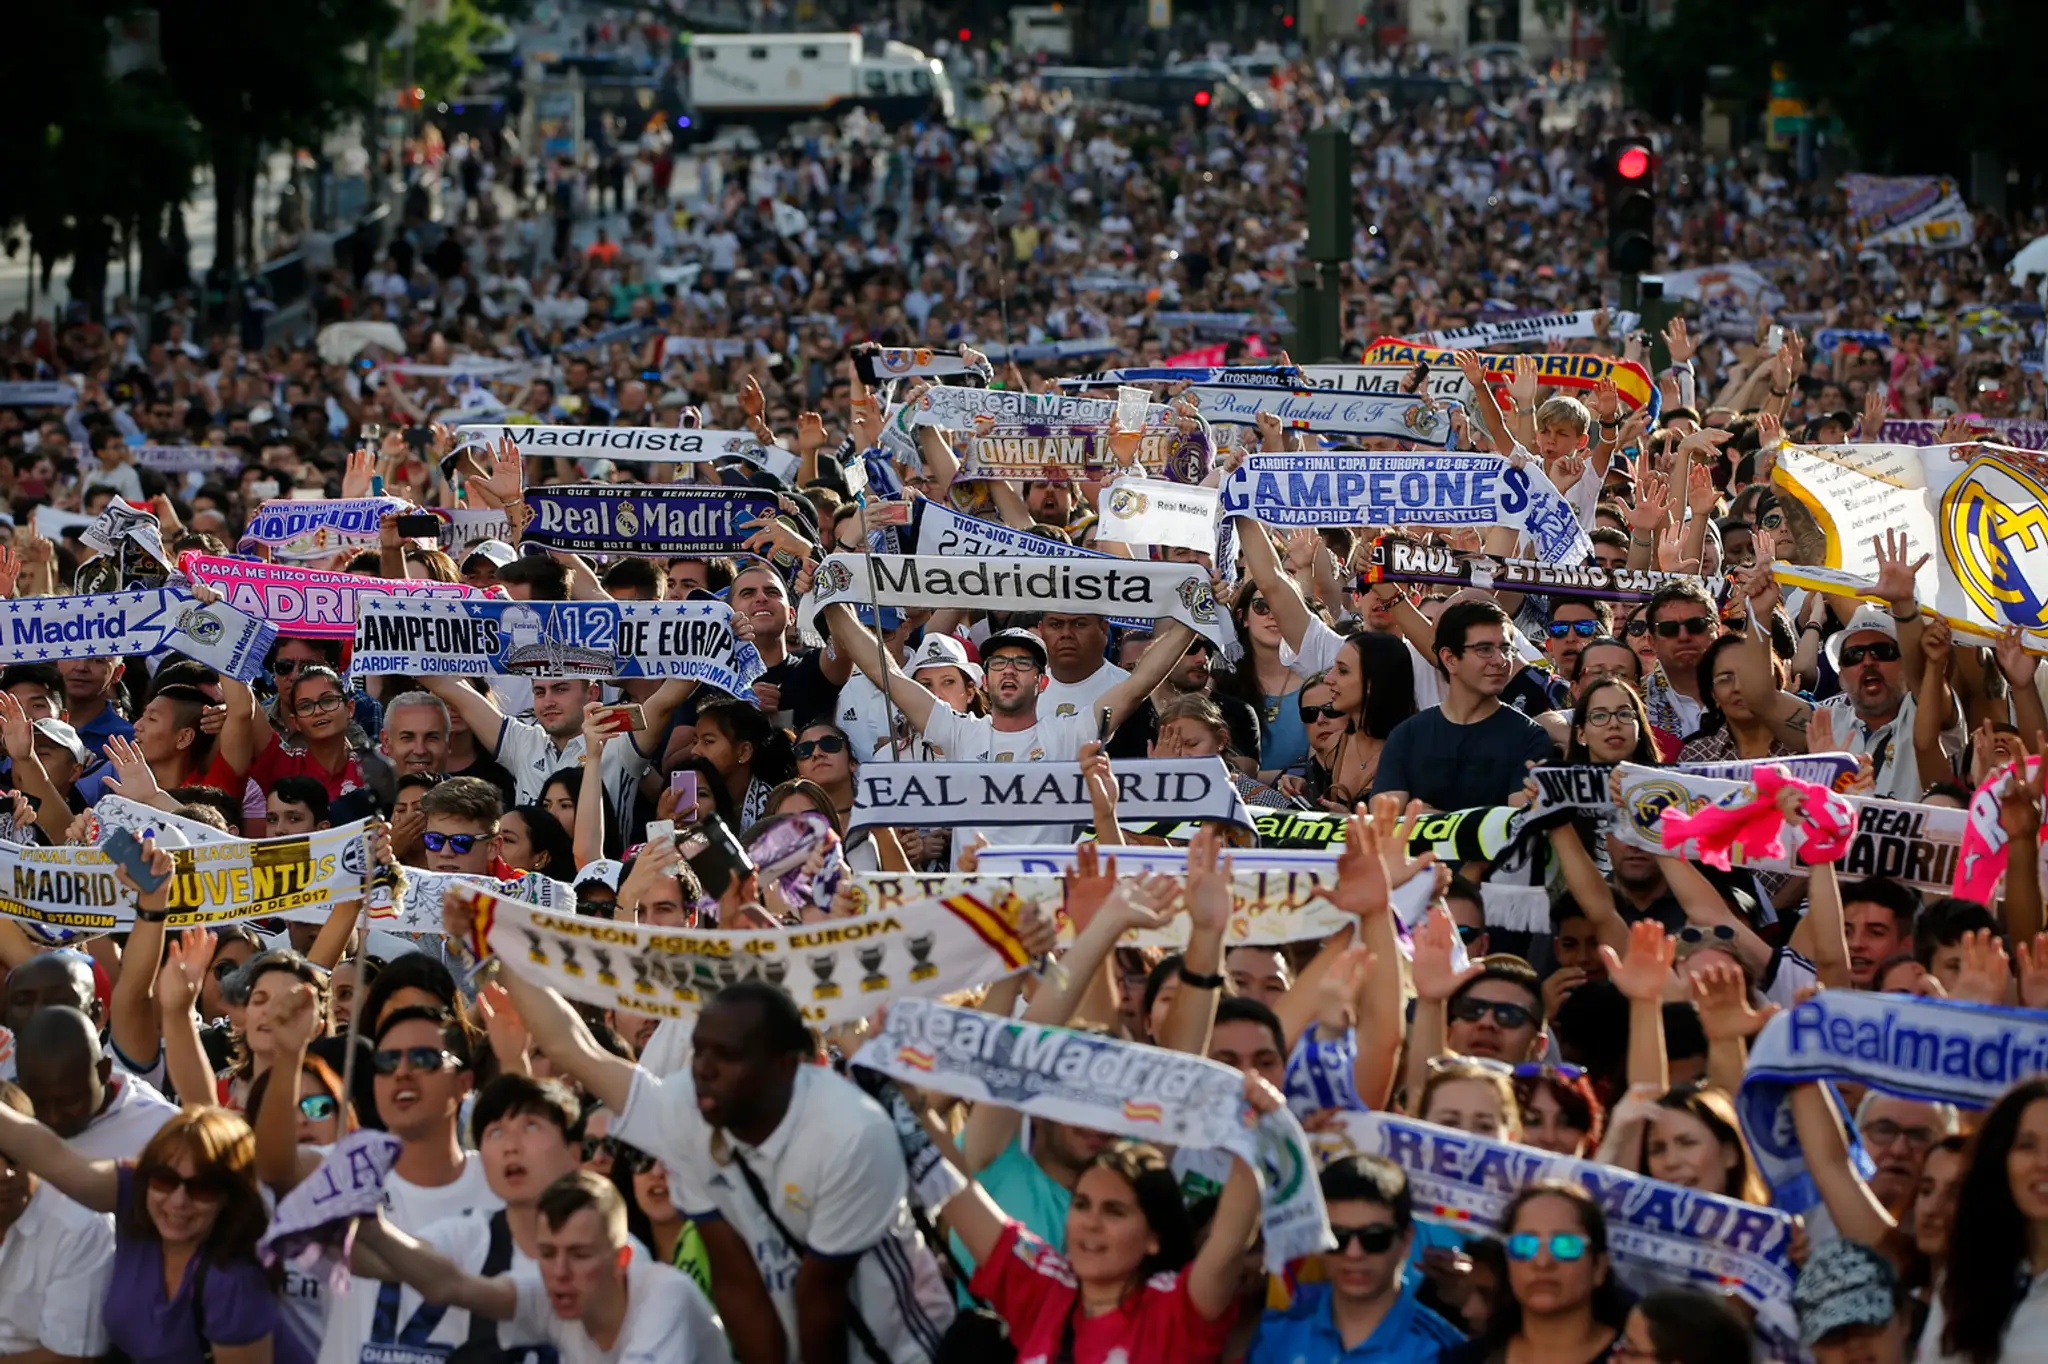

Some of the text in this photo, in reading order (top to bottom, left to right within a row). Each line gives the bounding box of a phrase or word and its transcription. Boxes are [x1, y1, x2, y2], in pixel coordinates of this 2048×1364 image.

[1496, 313, 1579, 332] MADRID
[1300, 376, 1342, 392] eal
[1356, 375, 1465, 394] Marid
[965, 389, 1118, 418] Real Madri
[1213, 393, 1260, 415] Real
[1271, 397, 1336, 422] Madrid
[502, 426, 703, 452] Madridista
[1251, 458, 1295, 470] CARDIFF
[1305, 458, 1335, 470] FINAL
[1339, 458, 1368, 470] COPA
[1370, 458, 1382, 470] DE
[1385, 458, 1425, 470] EUROPA
[567, 489, 590, 497] QUE
[598, 489, 631, 498] BOTE
[641, 490, 654, 498] EL
[662, 490, 726, 499] BERNABEU
[1221, 466, 1530, 514] CAMPEONES
[539, 499, 753, 538] Real Madri
[1157, 500, 1209, 517] Real Madrid
[1280, 510, 1350, 523] MADRID
[1400, 508, 1494, 521] JUVENTUS
[573, 539, 596, 548] QUE
[603, 540, 634, 549] BOTE
[642, 541, 653, 550] EL
[660, 542, 724, 551] BERNABEU
[200, 562, 243, 578] PAPÁ
[245, 566, 267, 579] ME
[270, 569, 307, 582] HIZO
[871, 557, 1153, 603] Madridista
[12, 610, 127, 645] Madrid
[563, 606, 615, 648] 12
[618, 621, 650, 656] DE
[225, 620, 257, 674] Real Madrid
[353, 657, 409, 672] CARDIFF
[421, 657, 488, 674] 03/06/2017
[646, 662, 664, 675] LA
[1858, 805, 1924, 839] REAL
[19, 848, 71, 865] FINAL
[187, 843, 258, 863] LEAGUE
[1836, 834, 1960, 885] ADRI
[13, 854, 336, 907] MADRID JUVENTUS
[47, 912, 116, 927] STADIUM
[194, 913, 213, 923] DE
[218, 904, 262, 921] JUNIO
[267, 900, 287, 911] DE
[291, 889, 328, 906] 2017
[788, 916, 903, 950] EUROPA
[887, 1000, 1009, 1059] Real
[1010, 1025, 1202, 1099] Madrid
[1790, 1000, 2048, 1084] Realmadri
[1381, 1121, 1541, 1194] REAL
